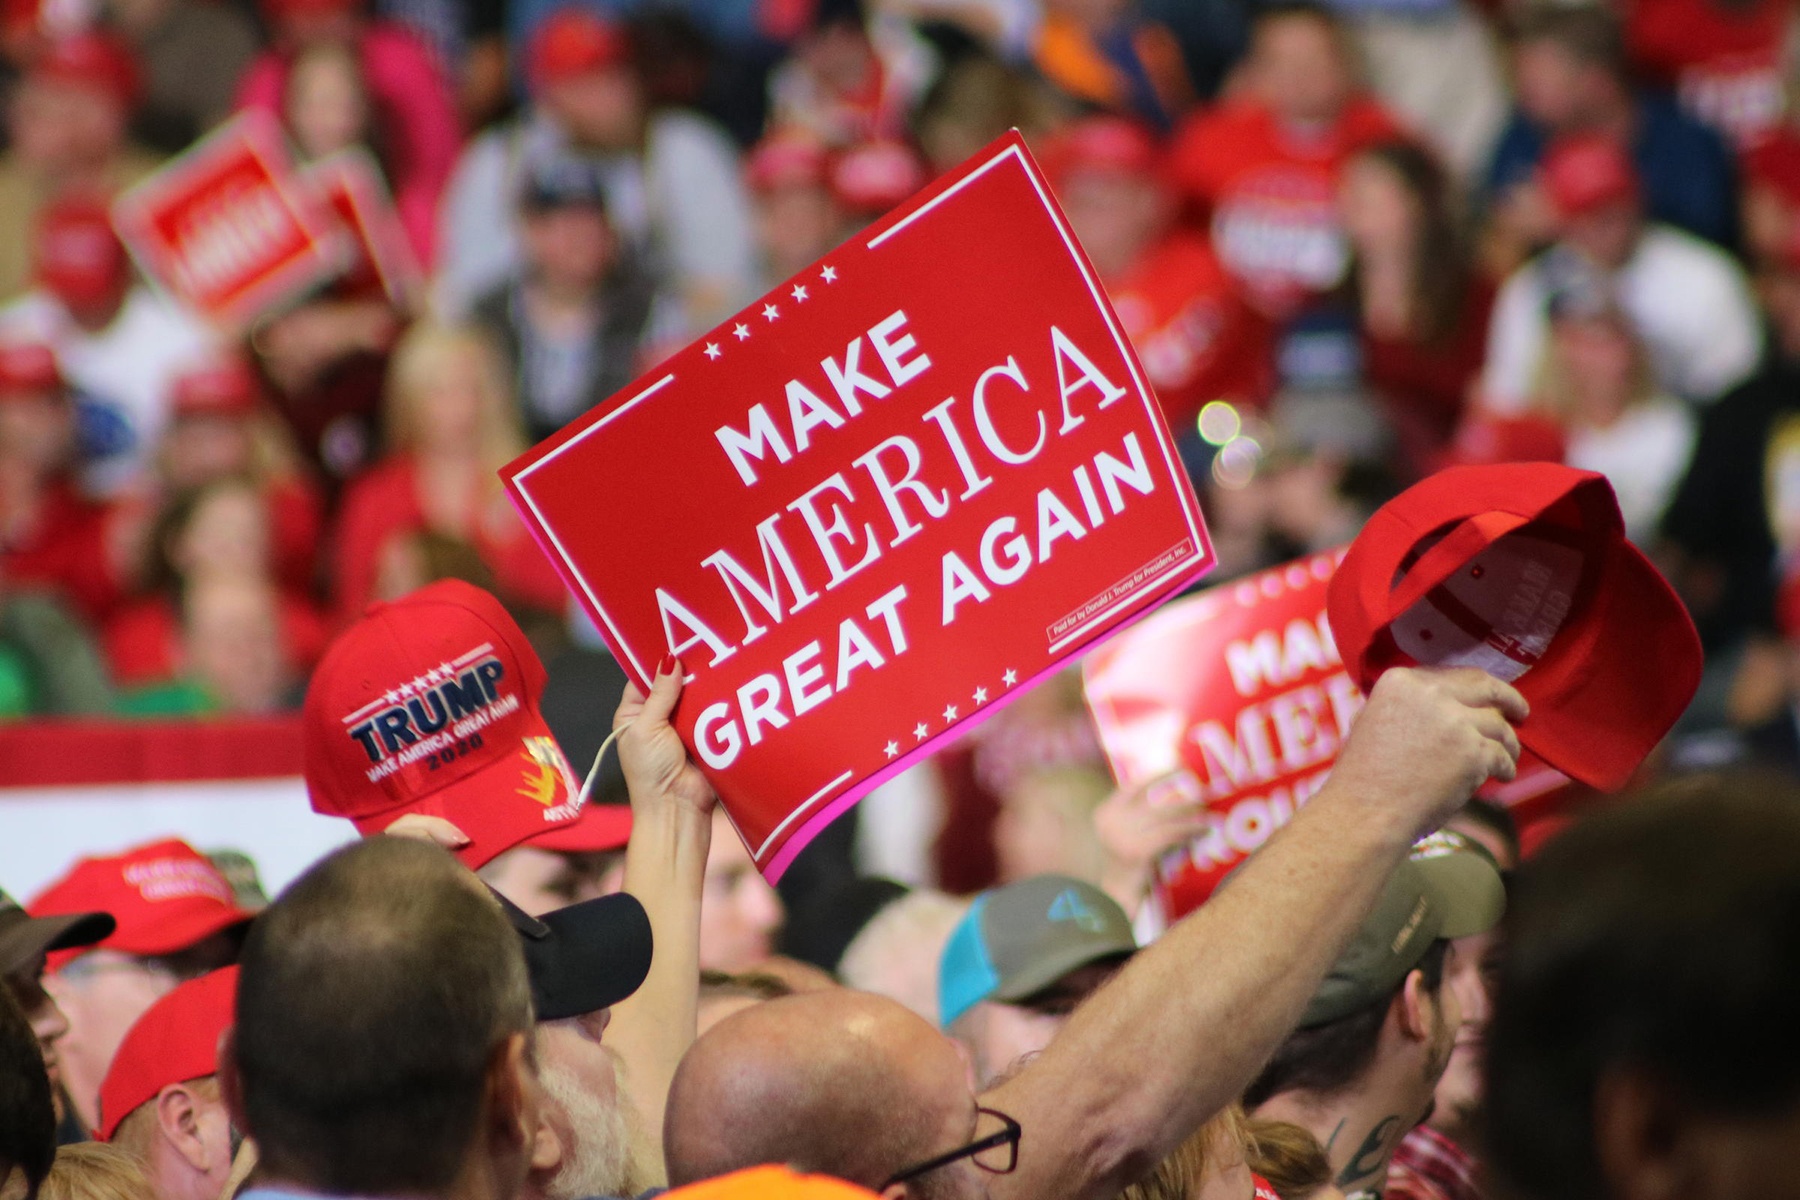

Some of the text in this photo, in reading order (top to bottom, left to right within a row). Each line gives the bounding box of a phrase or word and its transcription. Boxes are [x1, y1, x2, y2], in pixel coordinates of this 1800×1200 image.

[714, 309, 932, 487] MAKE
[654, 325, 1127, 687] AMERICA
[693, 431, 1155, 770] GREAT AGAIN
[1053, 619, 1068, 635] Paid
[1066, 614, 1077, 627] for
[1076, 608, 1086, 621] by
[1085, 593, 1109, 615] Donald
[1113, 578, 1135, 597] Trump
[1133, 572, 1144, 584] for
[1143, 553, 1175, 577] President,
[1173, 545, 1187, 558] Inc.
[347, 655, 504, 764] TRUMP
[365, 756, 400, 784] MAKE
[397, 730, 454, 768] AMERICA
[452, 710, 491, 739] GREAT
[425, 732, 484, 771] 2020
